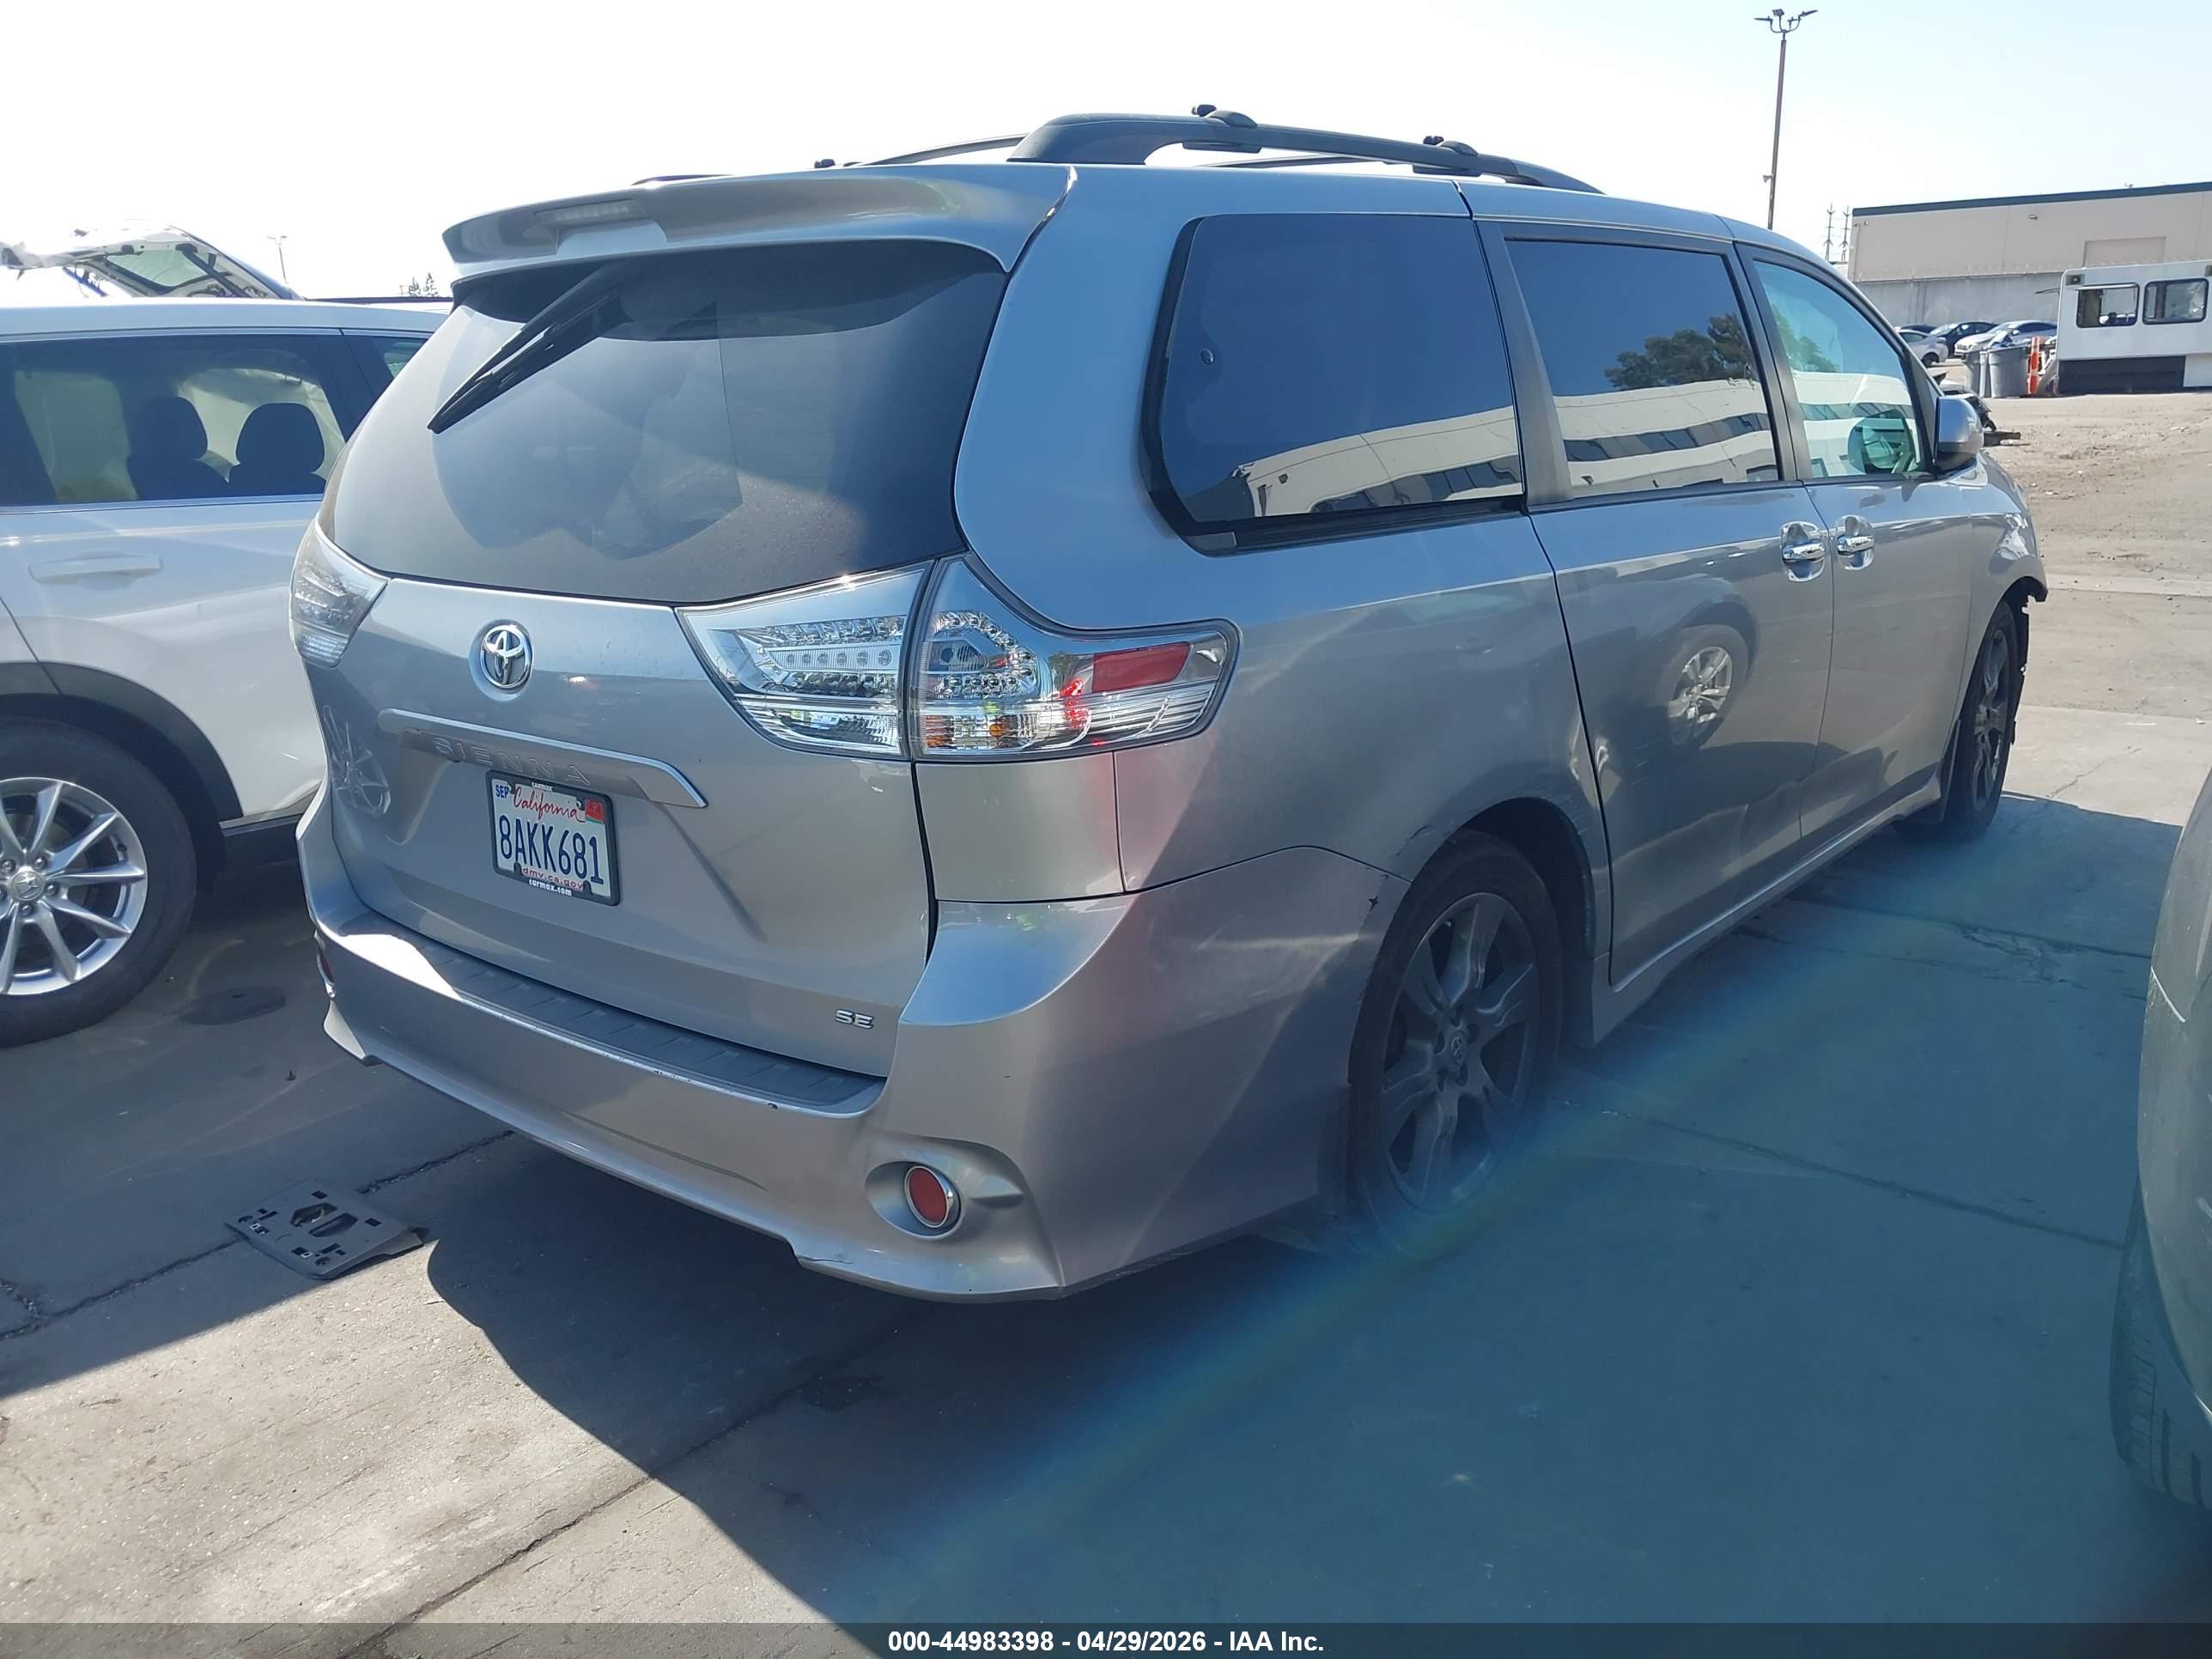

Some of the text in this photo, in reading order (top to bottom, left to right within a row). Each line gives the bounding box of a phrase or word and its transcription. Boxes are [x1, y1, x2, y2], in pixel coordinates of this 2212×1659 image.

[433, 737, 591, 786] SIENNA
[495, 784, 509, 799] SEP
[513, 786, 586, 821] California
[499, 814, 605, 885] 8AKK681
[522, 867, 584, 890] dmv.ca.gov
[528, 878, 573, 896] carmax.com
[835, 1008, 874, 1030] SE
